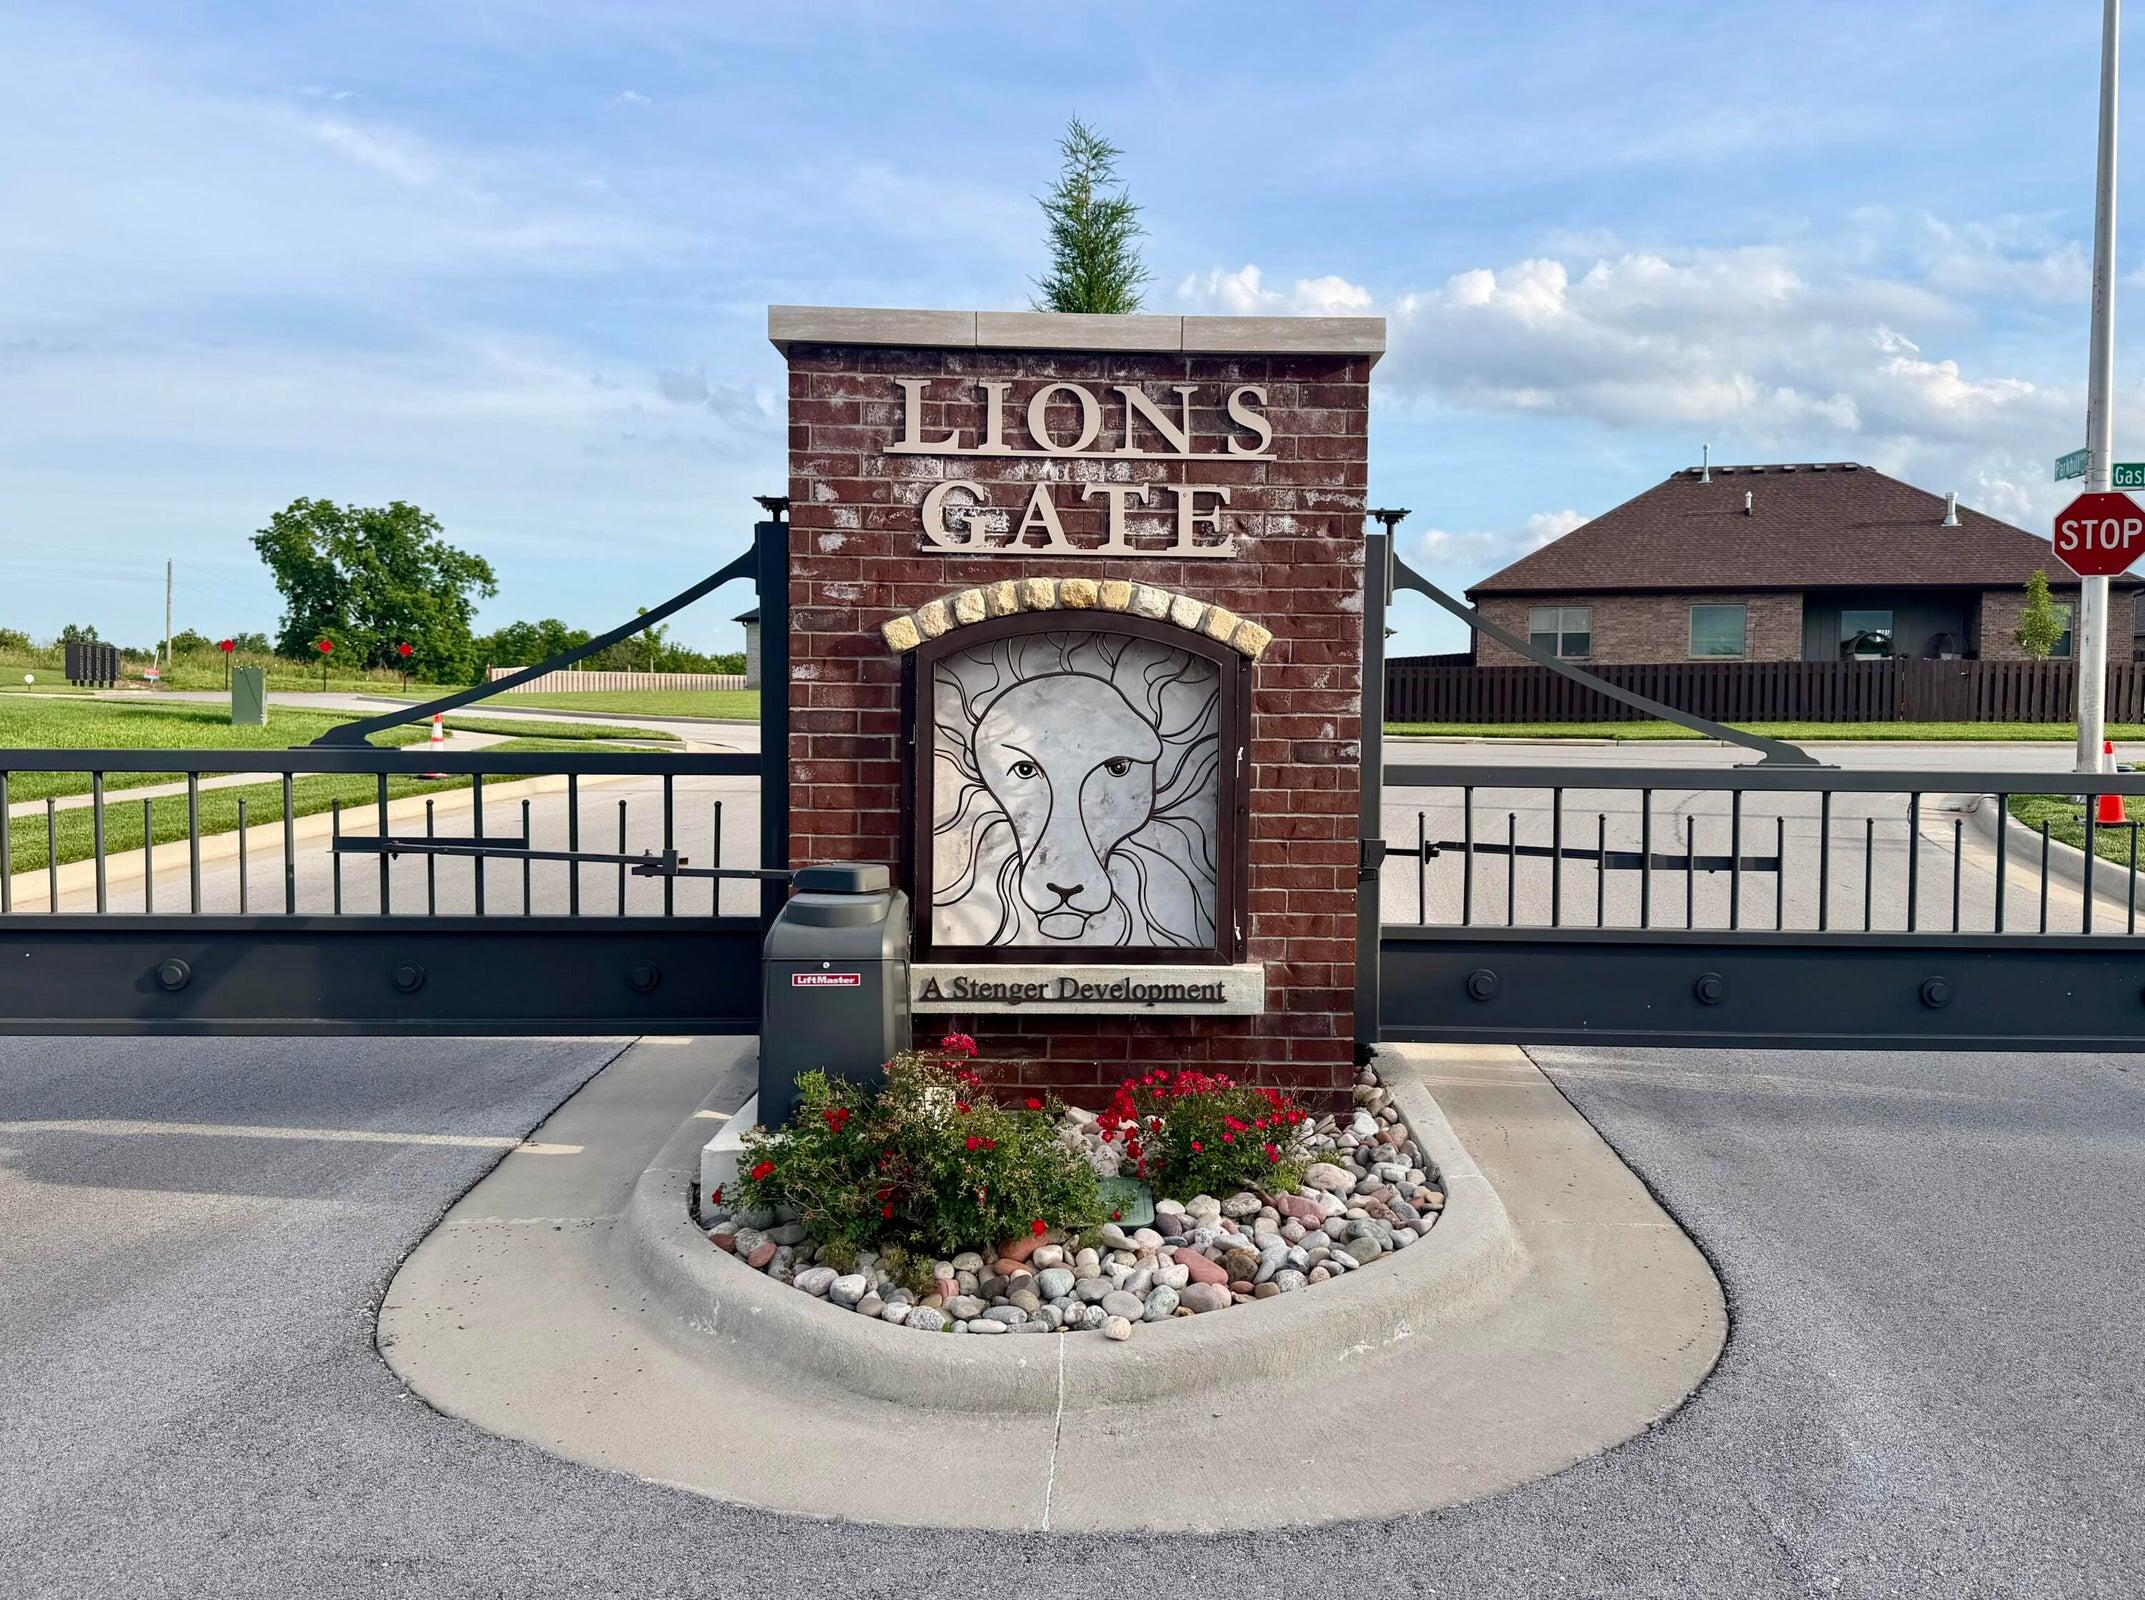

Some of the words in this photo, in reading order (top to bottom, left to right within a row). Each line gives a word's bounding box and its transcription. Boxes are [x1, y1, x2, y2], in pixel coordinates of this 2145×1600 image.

[893, 378, 1273, 456] LIONS
[2056, 453, 2080, 478] Parkhill
[2115, 465, 2145, 485] Gas
[920, 479, 1236, 552] GATE
[2059, 518, 2143, 551] STOP
[797, 975, 856, 985] LiftMaster
[921, 976, 945, 1000] A
[952, 976, 1049, 1005] Stenger
[1058, 977, 1226, 1006] Development
